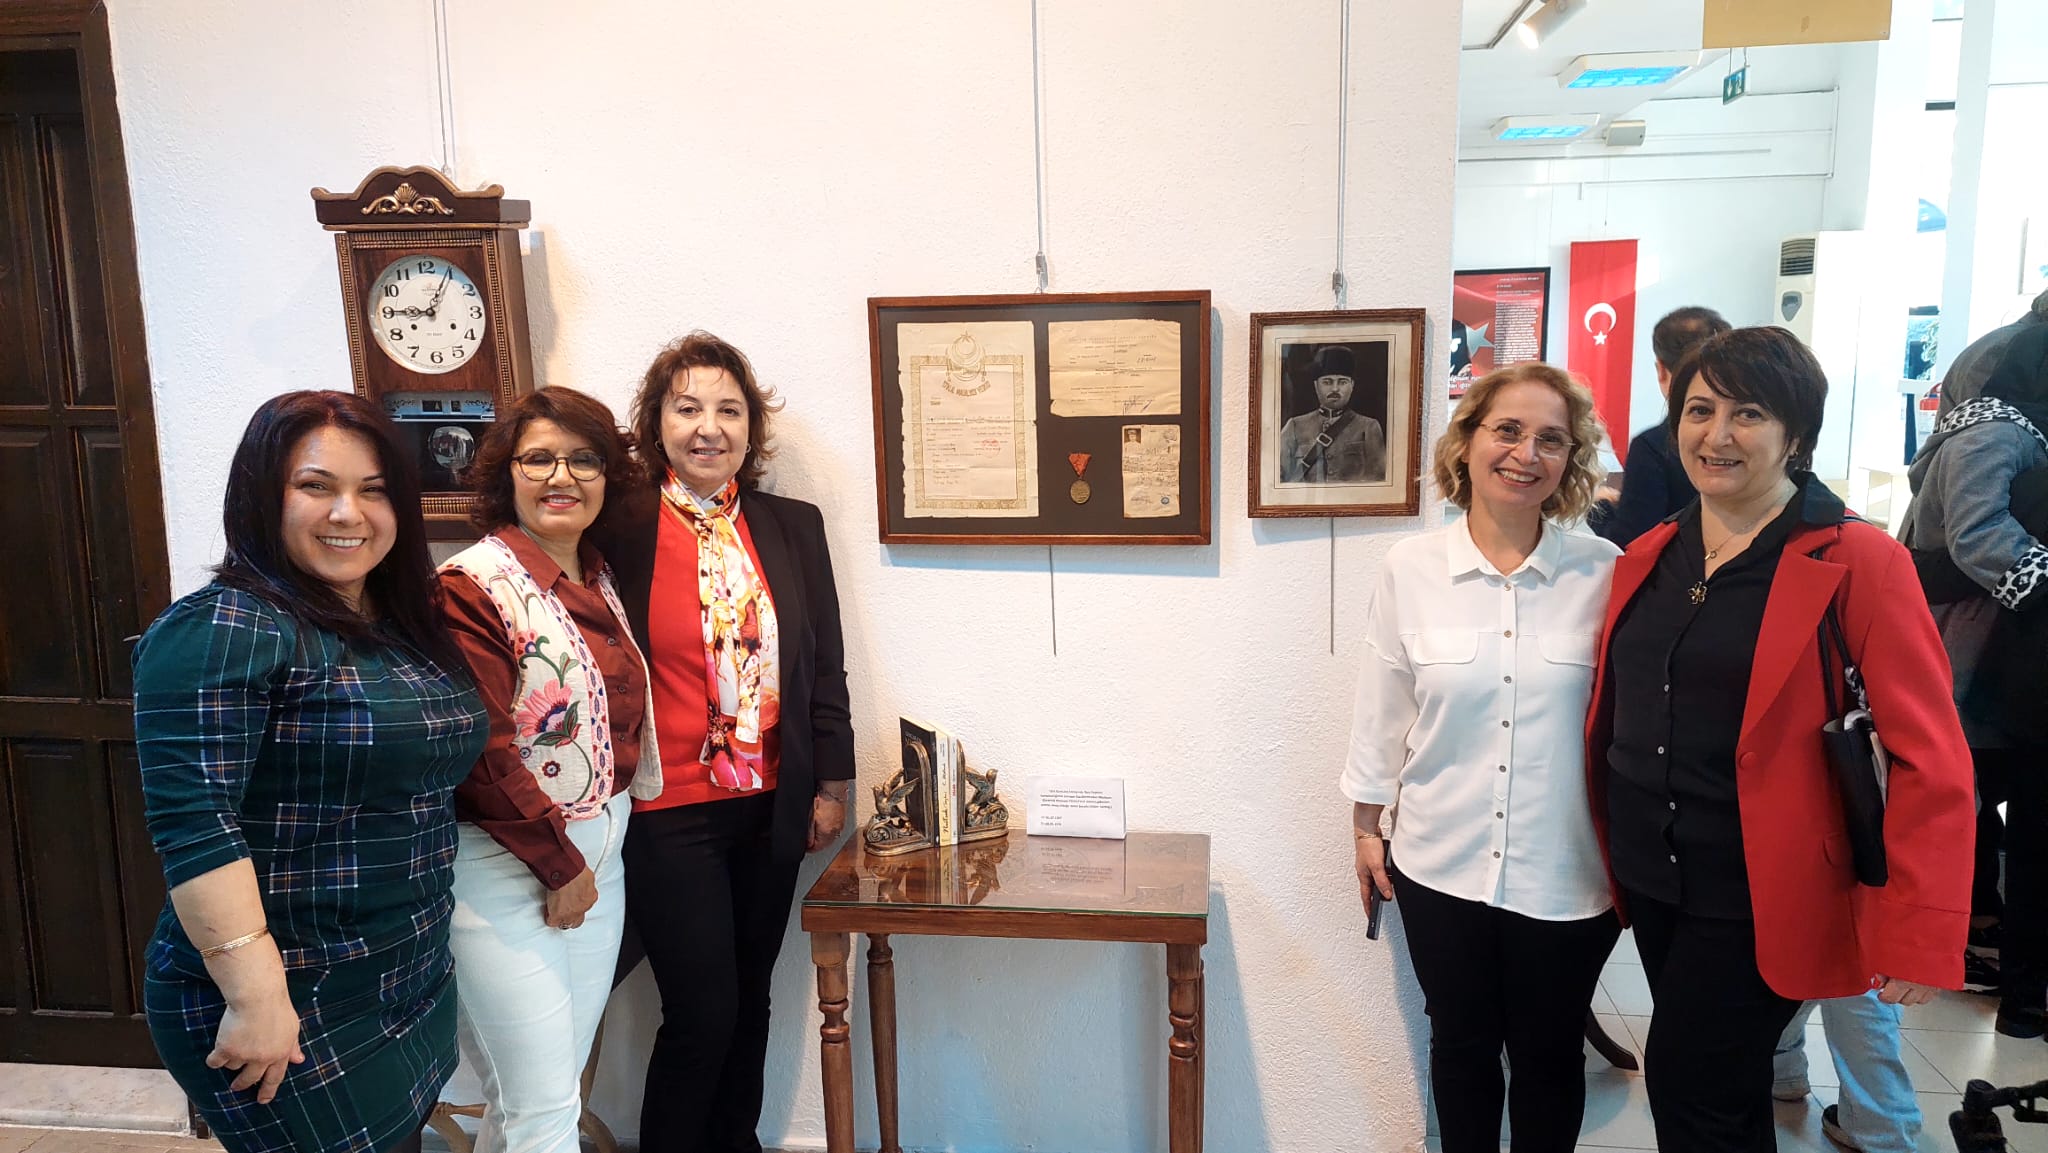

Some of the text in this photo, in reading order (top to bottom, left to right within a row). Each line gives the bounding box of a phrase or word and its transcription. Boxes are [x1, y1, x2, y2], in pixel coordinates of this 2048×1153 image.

[417, 260, 436, 275] 12
[396, 268, 410, 281] 11
[384, 284, 400, 298] 10
[462, 284, 476, 297] 2
[382, 306, 394, 319] 9
[470, 306, 482, 320] 3
[390, 328, 404, 341] 8
[464, 328, 476, 341] 4
[408, 345, 420, 358] 7
[431, 351, 443, 364] 6
[452, 345, 465, 358] 5
